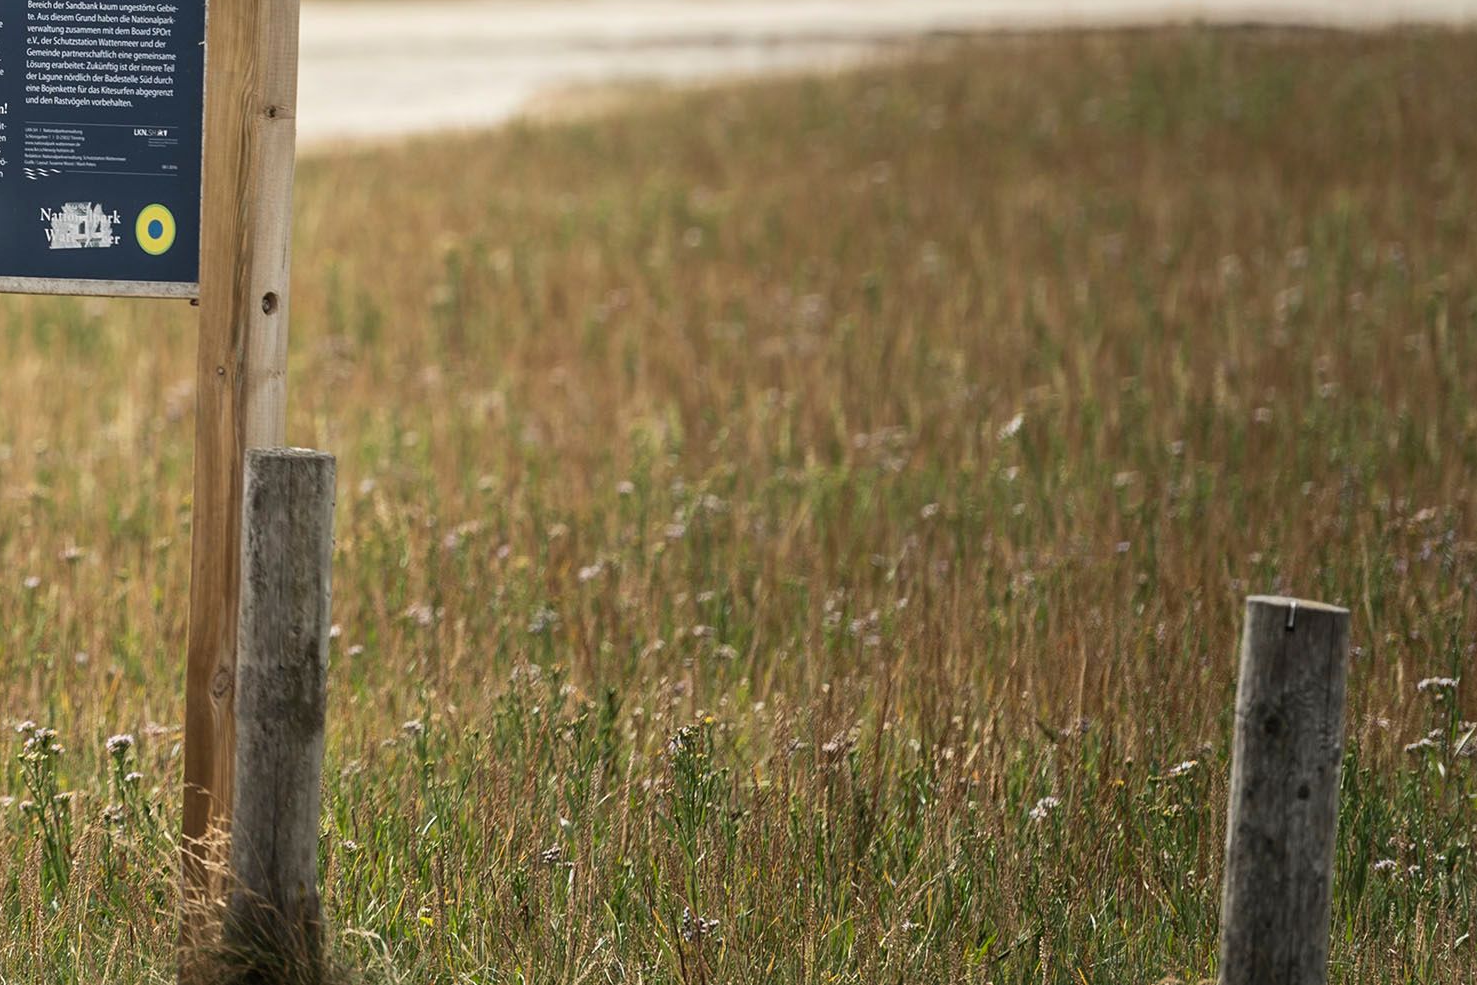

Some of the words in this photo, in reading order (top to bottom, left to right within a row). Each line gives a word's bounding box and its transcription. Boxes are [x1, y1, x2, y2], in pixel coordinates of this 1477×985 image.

[28, 0, 52, 9] Bereich
[53, 1, 64, 9] der
[66, 1, 98, 10] Sandbank
[100, 2, 118, 10] kaum
[119, 3, 155, 13] ungestörte
[157, 4, 178, 12] Gebie-
[37, 13, 49, 21] Aus
[51, 13, 74, 21] diesem
[75, 13, 96, 22] Grund
[98, 14, 118, 22] haben
[120, 15, 130, 23] die
[132, 15, 175, 25] Nationalpark-
[28, 24, 64, 35] verwaltung
[115, 27, 130, 35] dem
[131, 27, 151, 35] Board
[41, 36, 52, 45] der
[54, 37, 97, 46] Schutzstation
[99, 39, 139, 47] Wattenmeer
[155, 40, 166, 48] der
